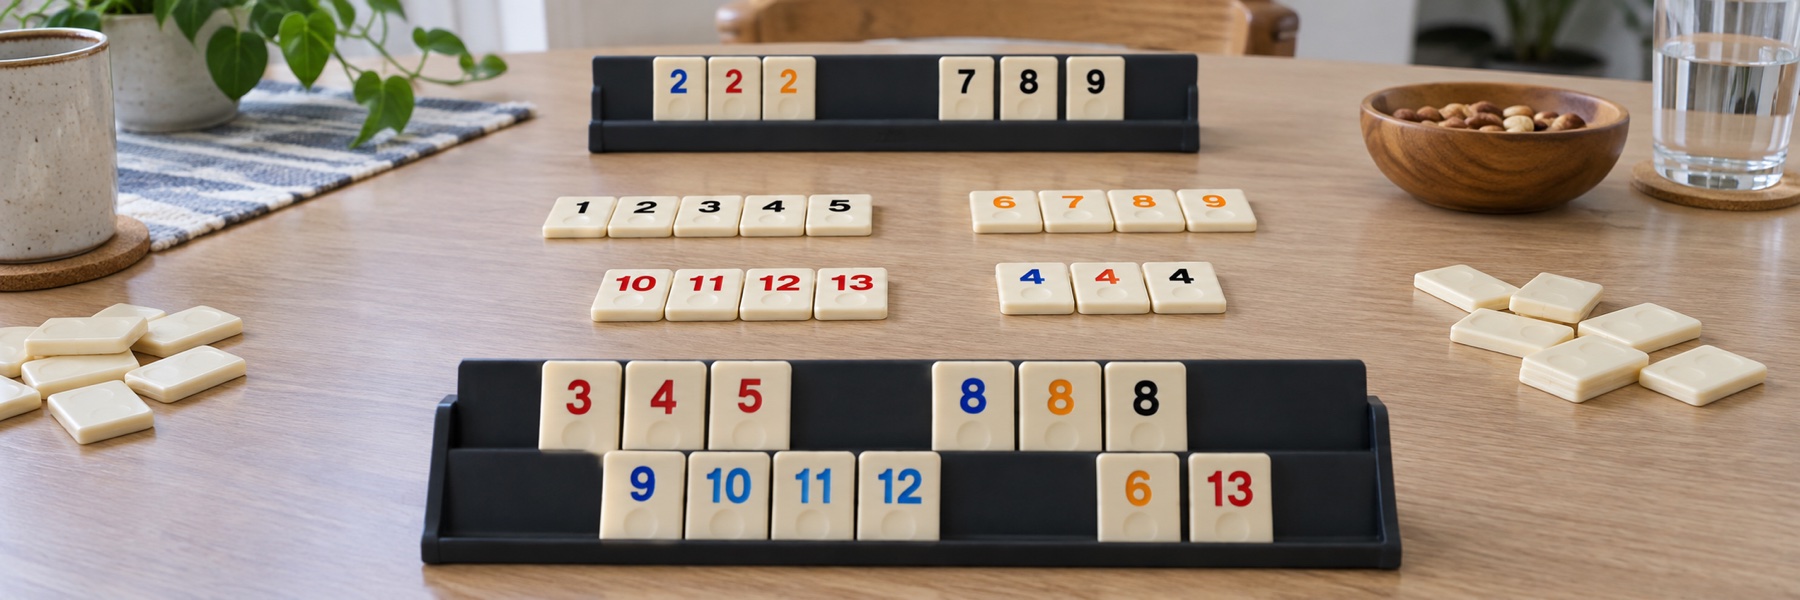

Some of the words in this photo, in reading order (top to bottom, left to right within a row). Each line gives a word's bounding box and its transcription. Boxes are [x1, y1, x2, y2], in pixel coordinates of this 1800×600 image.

[671, 69, 687, 93] 2
[726, 69, 742, 93] 2
[780, 69, 797, 93] 2
[958, 69, 975, 93] 7
[1020, 69, 1038, 94] 8
[1087, 69, 1105, 94] 9
[577, 202, 589, 213] 1
[634, 201, 657, 213] 2
[699, 201, 720, 213] 3
[762, 201, 785, 212] 4
[829, 200, 850, 212] 5
[993, 196, 1016, 208] 6
[1062, 196, 1083, 208] 7
[1133, 195, 1156, 208] 8
[1202, 195, 1226, 208] 9
[616, 276, 656, 291] 10
[690, 276, 723, 291] 11
[760, 275, 800, 291] 12
[832, 275, 873, 290] 13
[1020, 269, 1045, 284] 4
[1095, 269, 1119, 284] 4
[1169, 269, 1194, 283] 4
[566, 379, 591, 415] 3
[651, 380, 676, 414] 4
[738, 379, 762, 413] 5
[960, 378, 986, 414] 8
[1047, 379, 1074, 415] 8
[1133, 380, 1159, 416] 8
[631, 466, 655, 501] 9
[707, 468, 751, 504] 10
[795, 468, 831, 503] 11
[878, 468, 922, 504] 12
[1125, 470, 1152, 506] 6
[1208, 471, 1253, 507] 13
